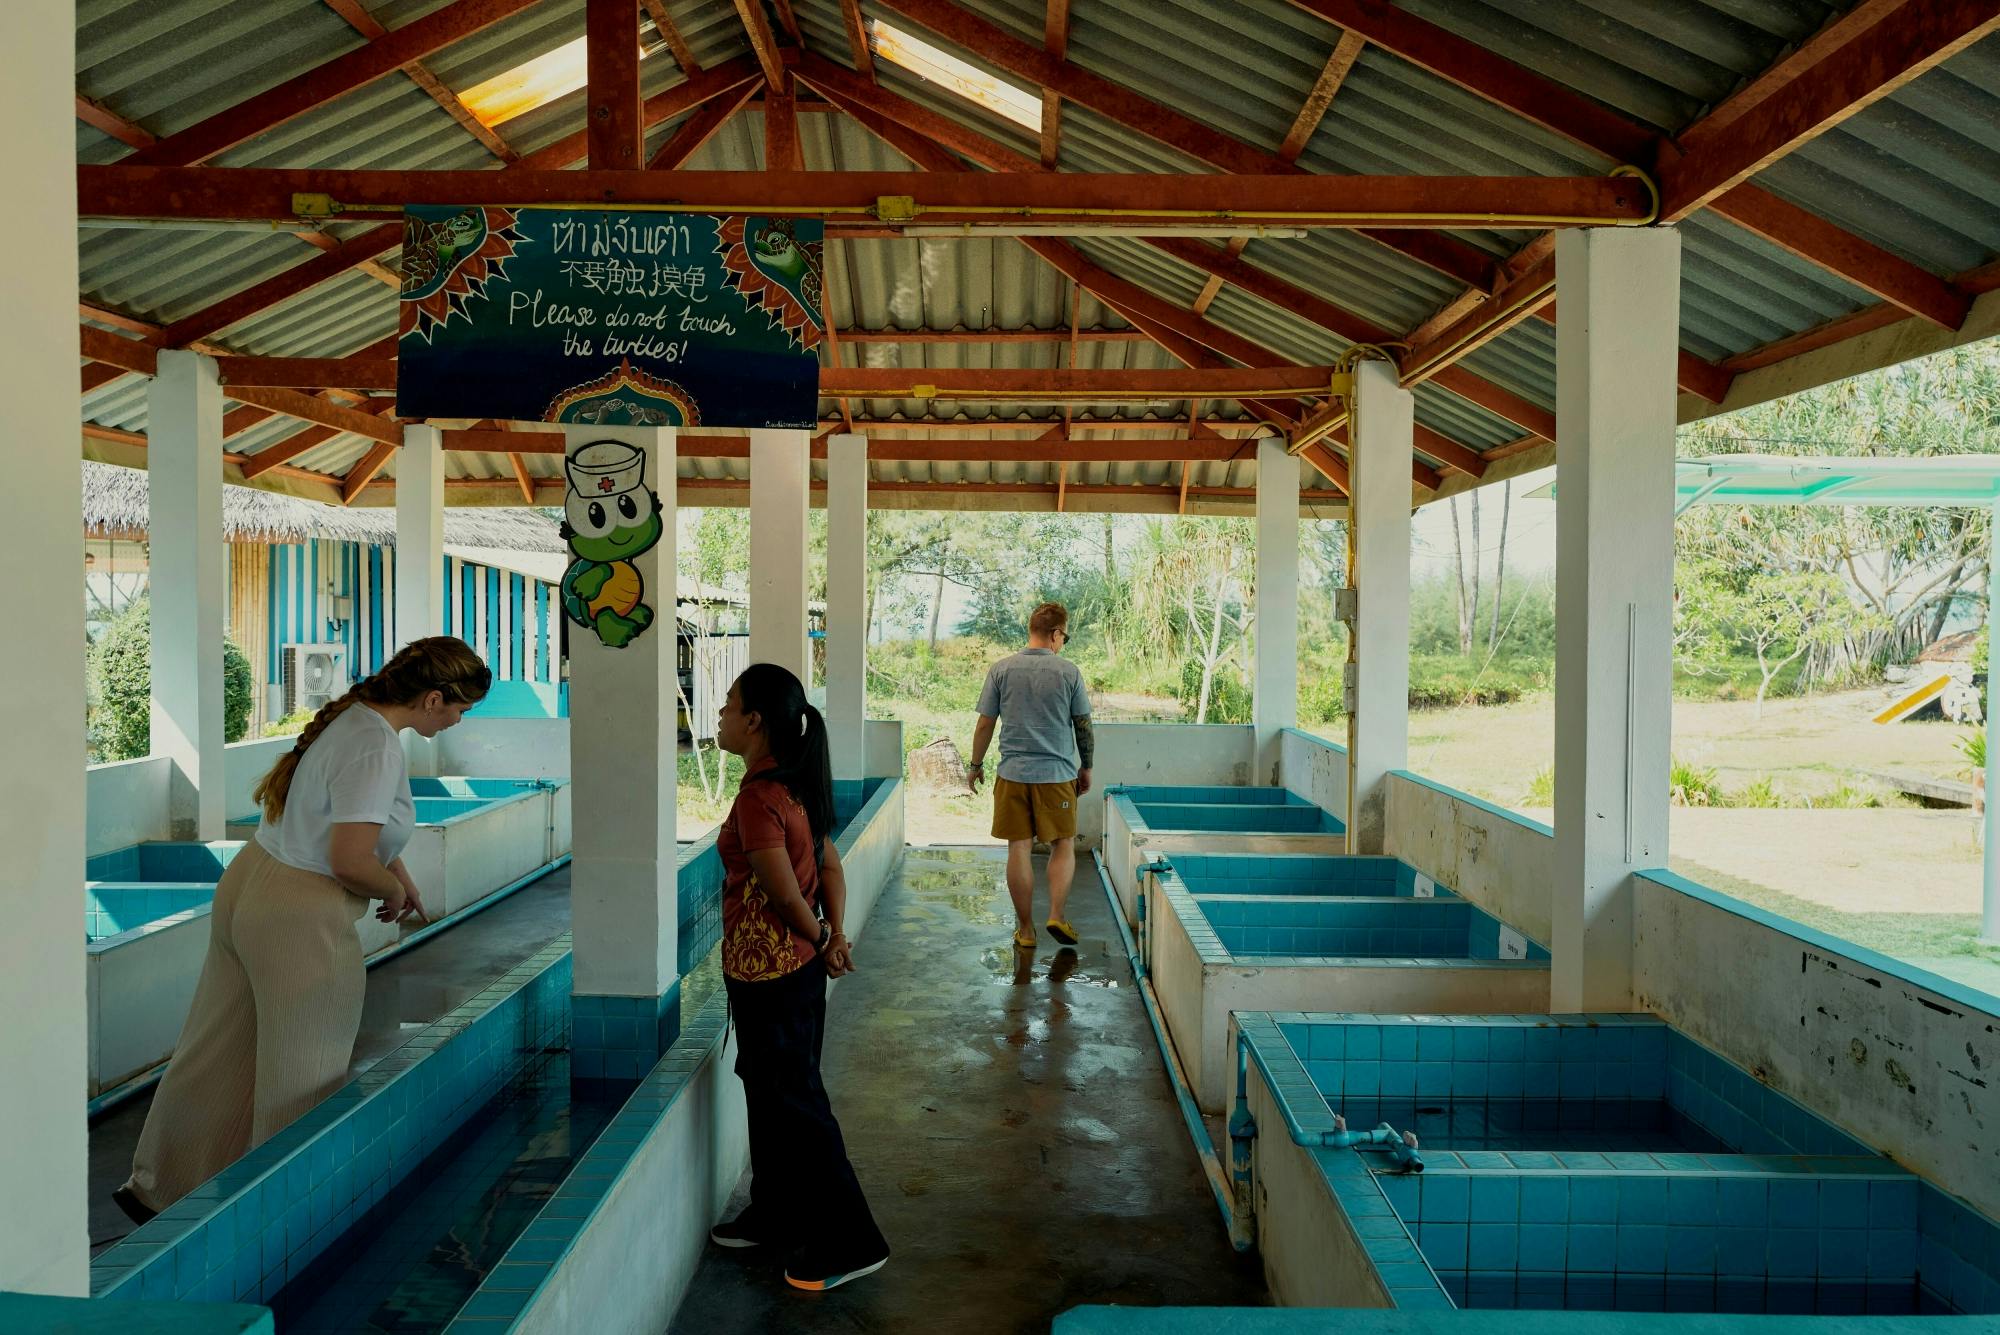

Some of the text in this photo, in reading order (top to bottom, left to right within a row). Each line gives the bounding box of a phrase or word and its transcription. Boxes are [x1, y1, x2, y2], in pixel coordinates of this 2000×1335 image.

[560, 257, 709, 303] 不要触摸龟
[509, 288, 737, 336] Please do not touch
[562, 328, 688, 364] the turtles!
